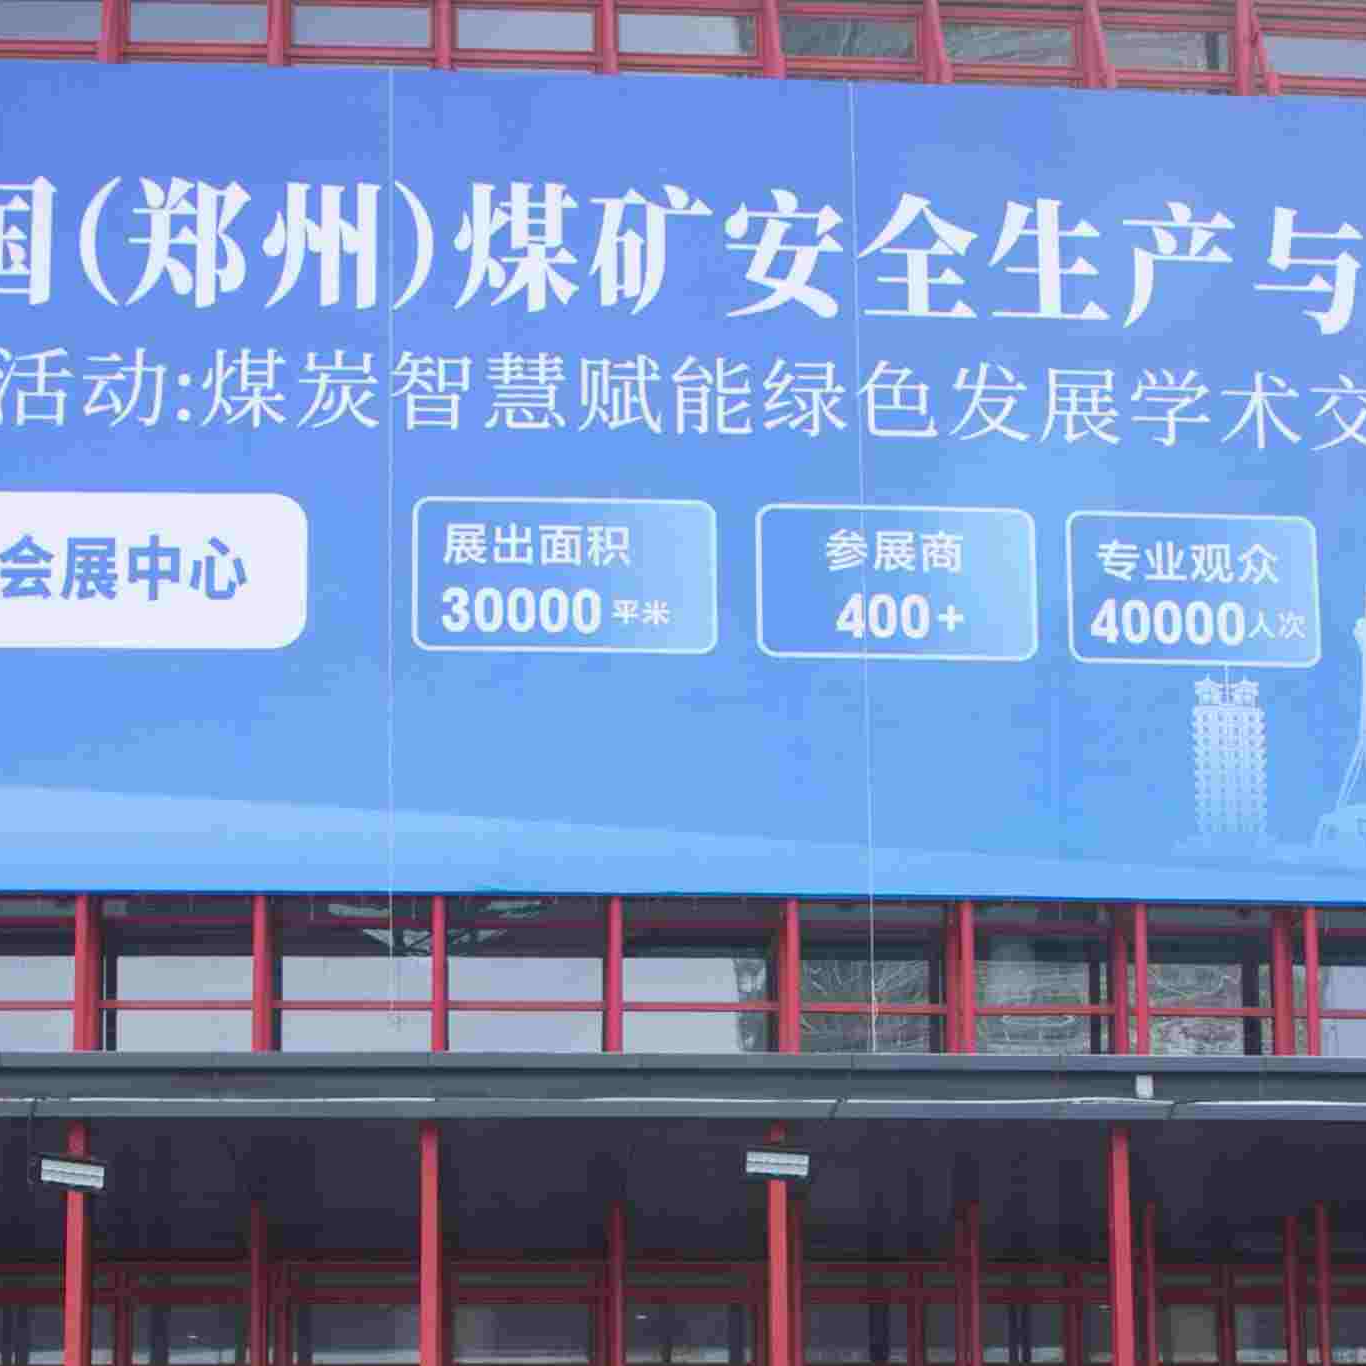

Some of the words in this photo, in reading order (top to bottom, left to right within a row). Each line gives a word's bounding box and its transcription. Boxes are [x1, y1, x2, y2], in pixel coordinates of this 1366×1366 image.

[443, 523, 631, 568] 展出面积
[826, 528, 963, 574] 参展商
[1097, 539, 1280, 585] 专业观众
[836, 592, 965, 640] 400+
